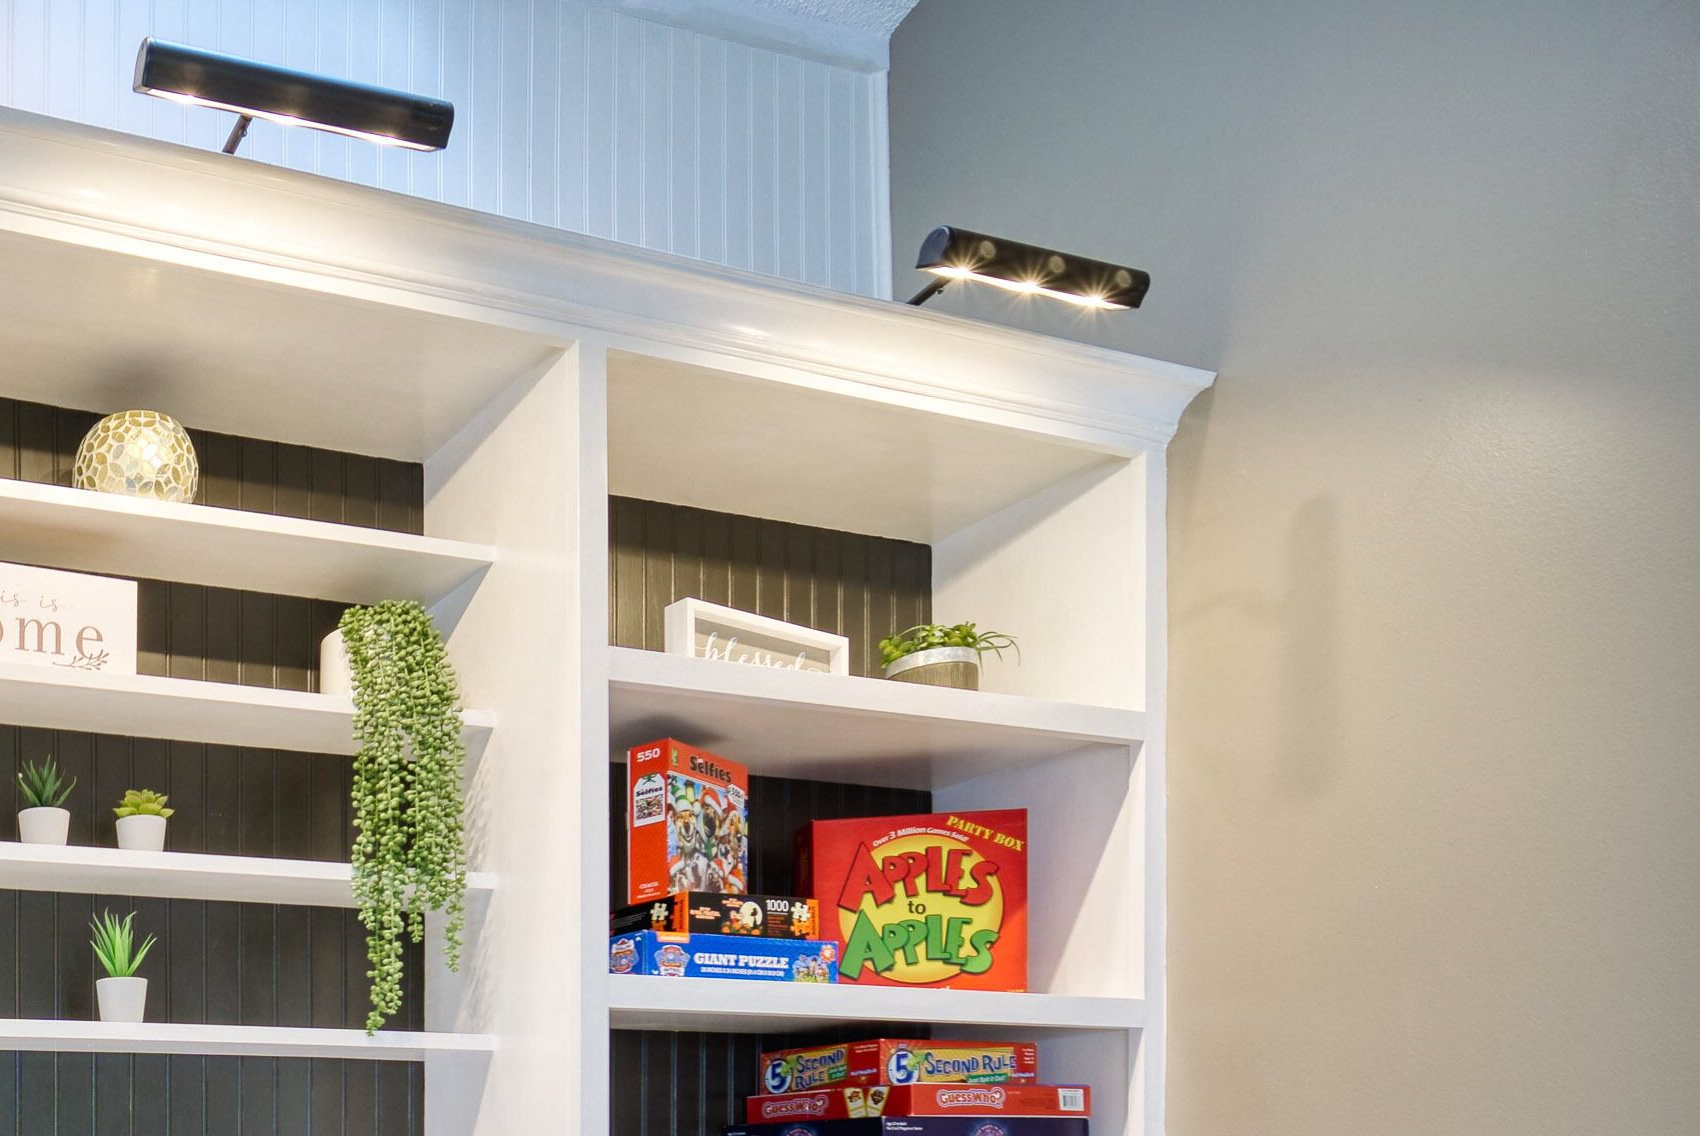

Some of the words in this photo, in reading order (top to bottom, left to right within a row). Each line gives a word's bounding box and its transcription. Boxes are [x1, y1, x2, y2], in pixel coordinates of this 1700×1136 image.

[39, 594, 60, 612] is
[636, 748, 661, 762] 550
[689, 755, 732, 783] Selfies
[636, 786, 663, 798] Selfies
[872, 836, 890, 848] Over
[889, 831, 896, 840] 3
[897, 826, 927, 837] Million
[926, 826, 951, 836] Games
[946, 815, 994, 840] PARTY
[994, 832, 1025, 852] BOX
[837, 840, 1000, 914] APPLES
[765, 899, 790, 912] 1000
[907, 900, 927, 915] to
[838, 909, 999, 980] APPLES
[693, 952, 737, 966] GIANT
[737, 953, 790, 969] PUZZLE
[770, 1060, 788, 1091] 5
[795, 1049, 845, 1073] SECOND
[894, 1053, 914, 1084] 5
[924, 1052, 980, 1075] SECOND
[982, 1055, 1017, 1072] RULE
[794, 1070, 825, 1089] RULE
